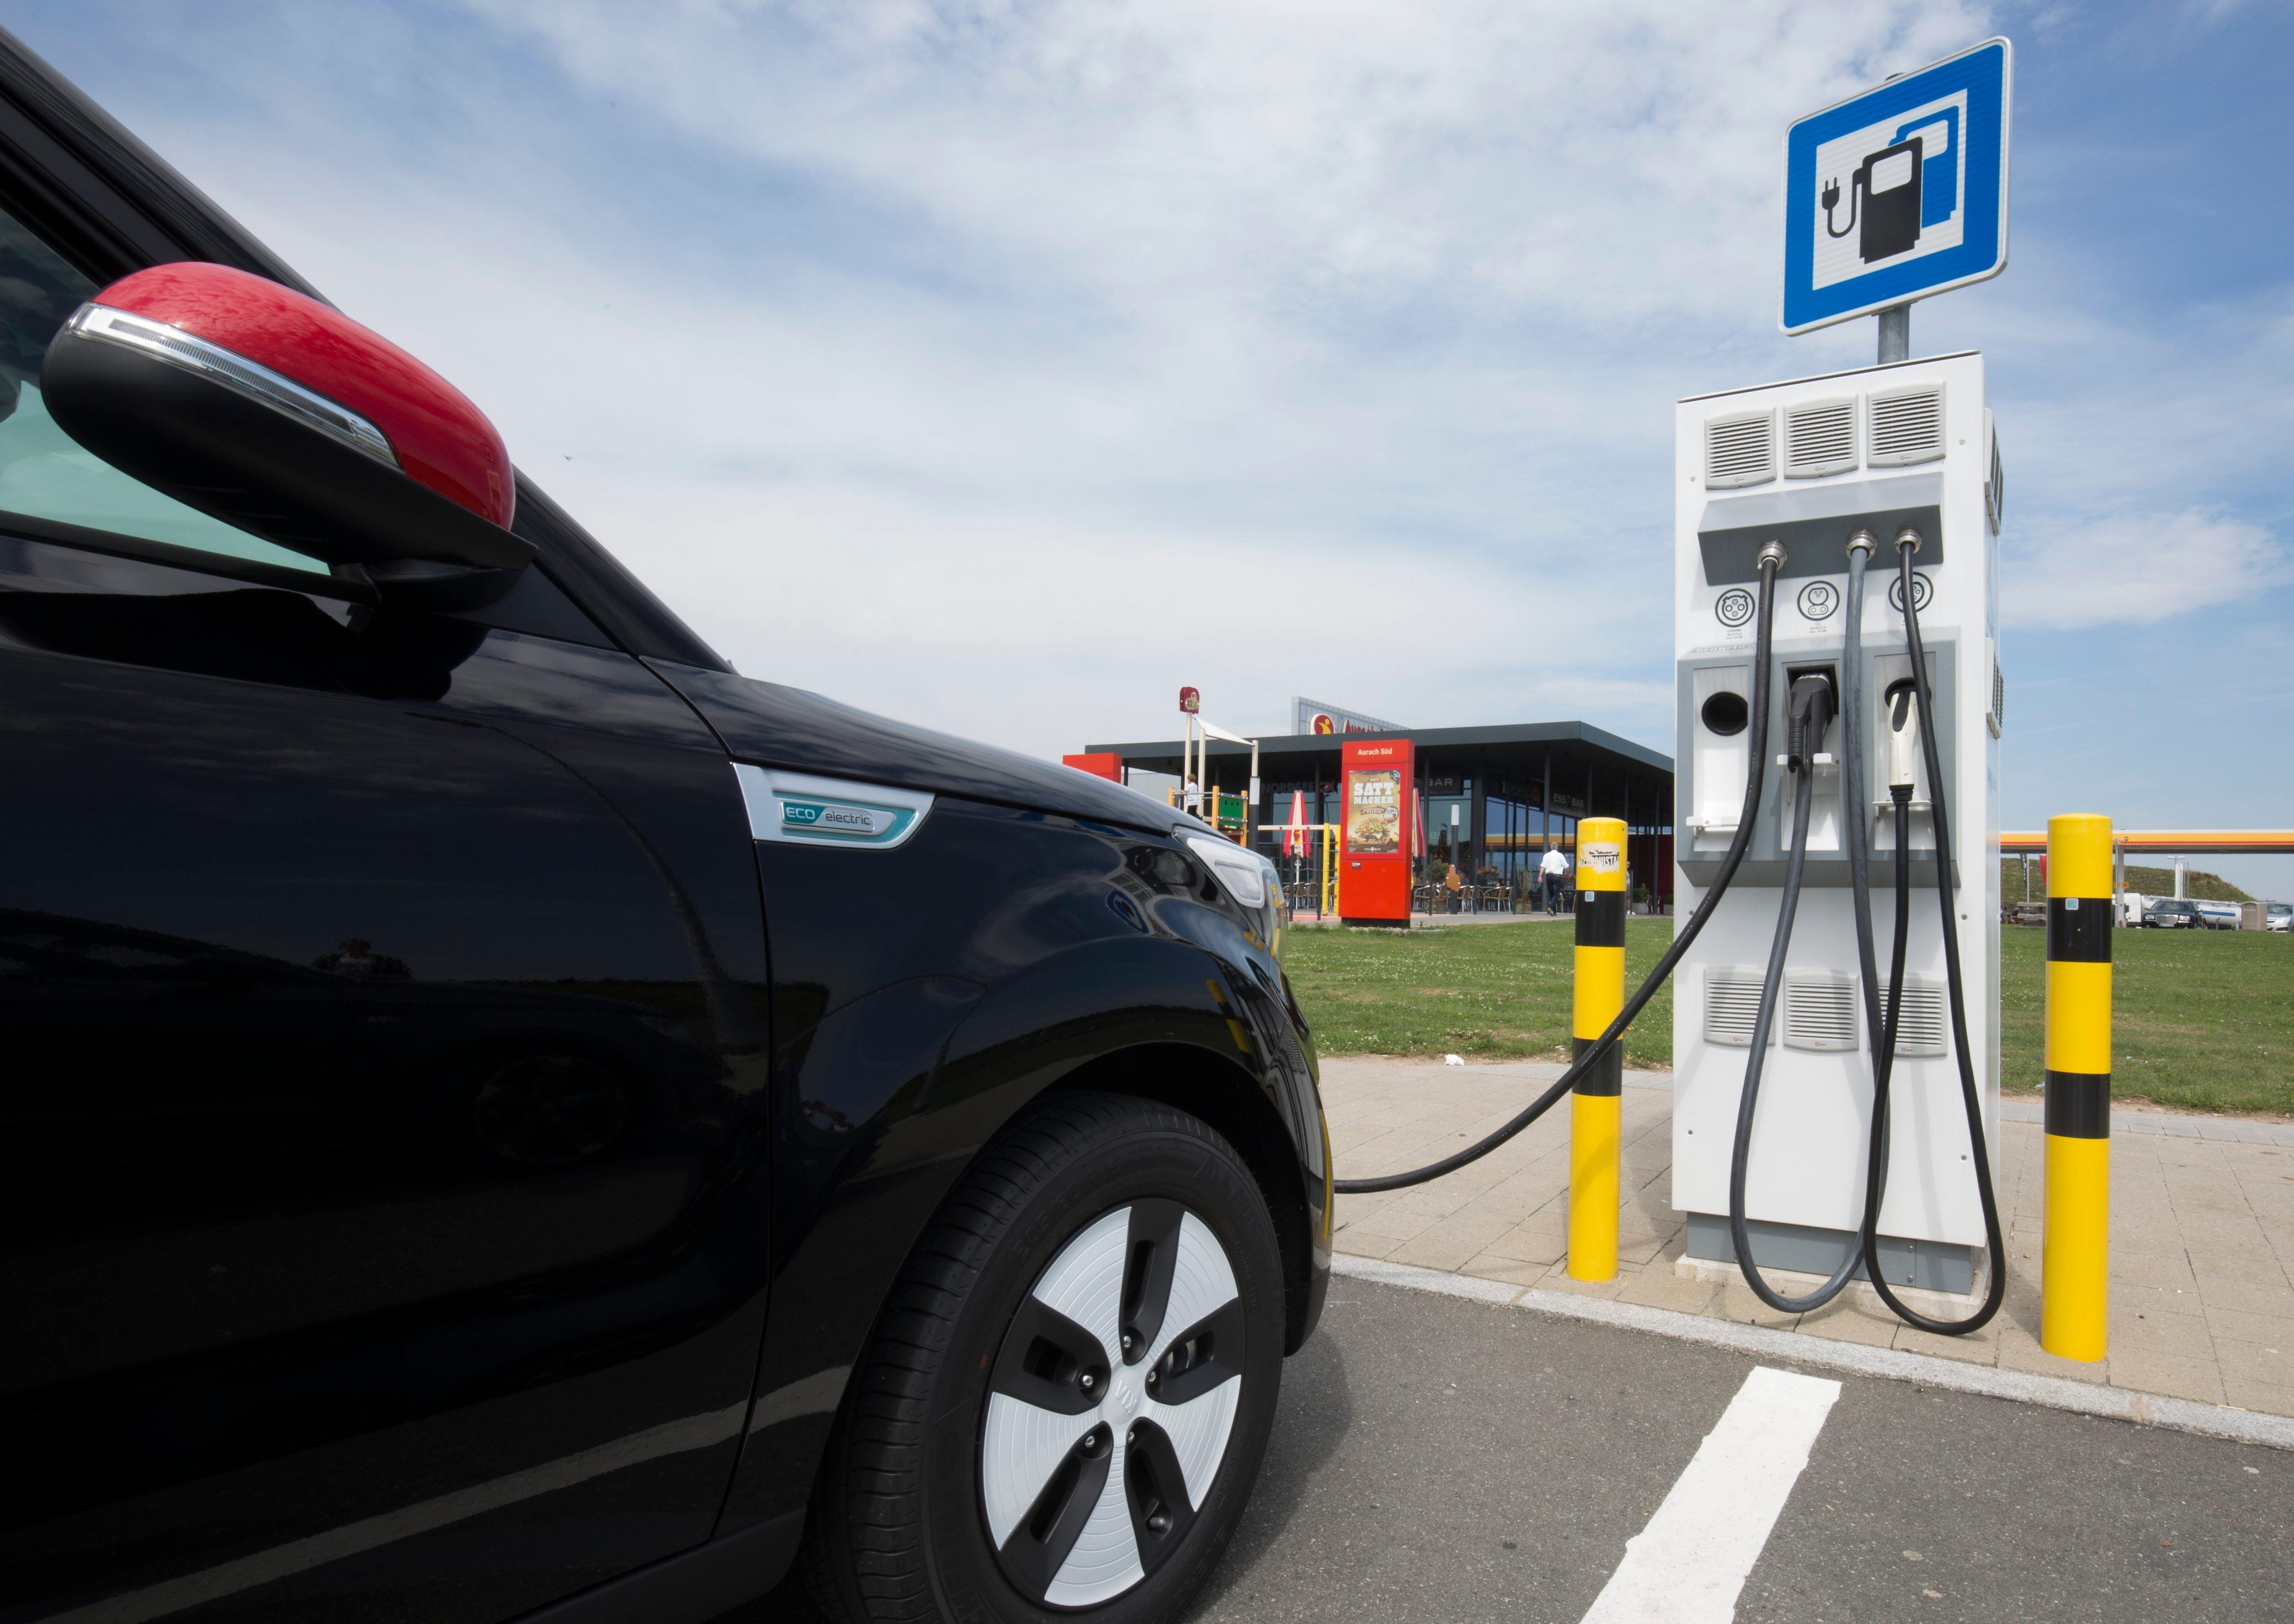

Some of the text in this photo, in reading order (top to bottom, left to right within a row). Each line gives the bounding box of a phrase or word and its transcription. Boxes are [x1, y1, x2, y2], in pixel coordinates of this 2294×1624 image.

[1354, 782, 1394, 797] SATT
[1354, 796, 1394, 805] MACHER
[1572, 798, 1584, 808] BAR
[786, 807, 871, 826] ECO electric
[1012, 1208, 1050, 1262] 205
[1055, 1182, 1081, 1212] 60
[1115, 1379, 1137, 1416] KIA
